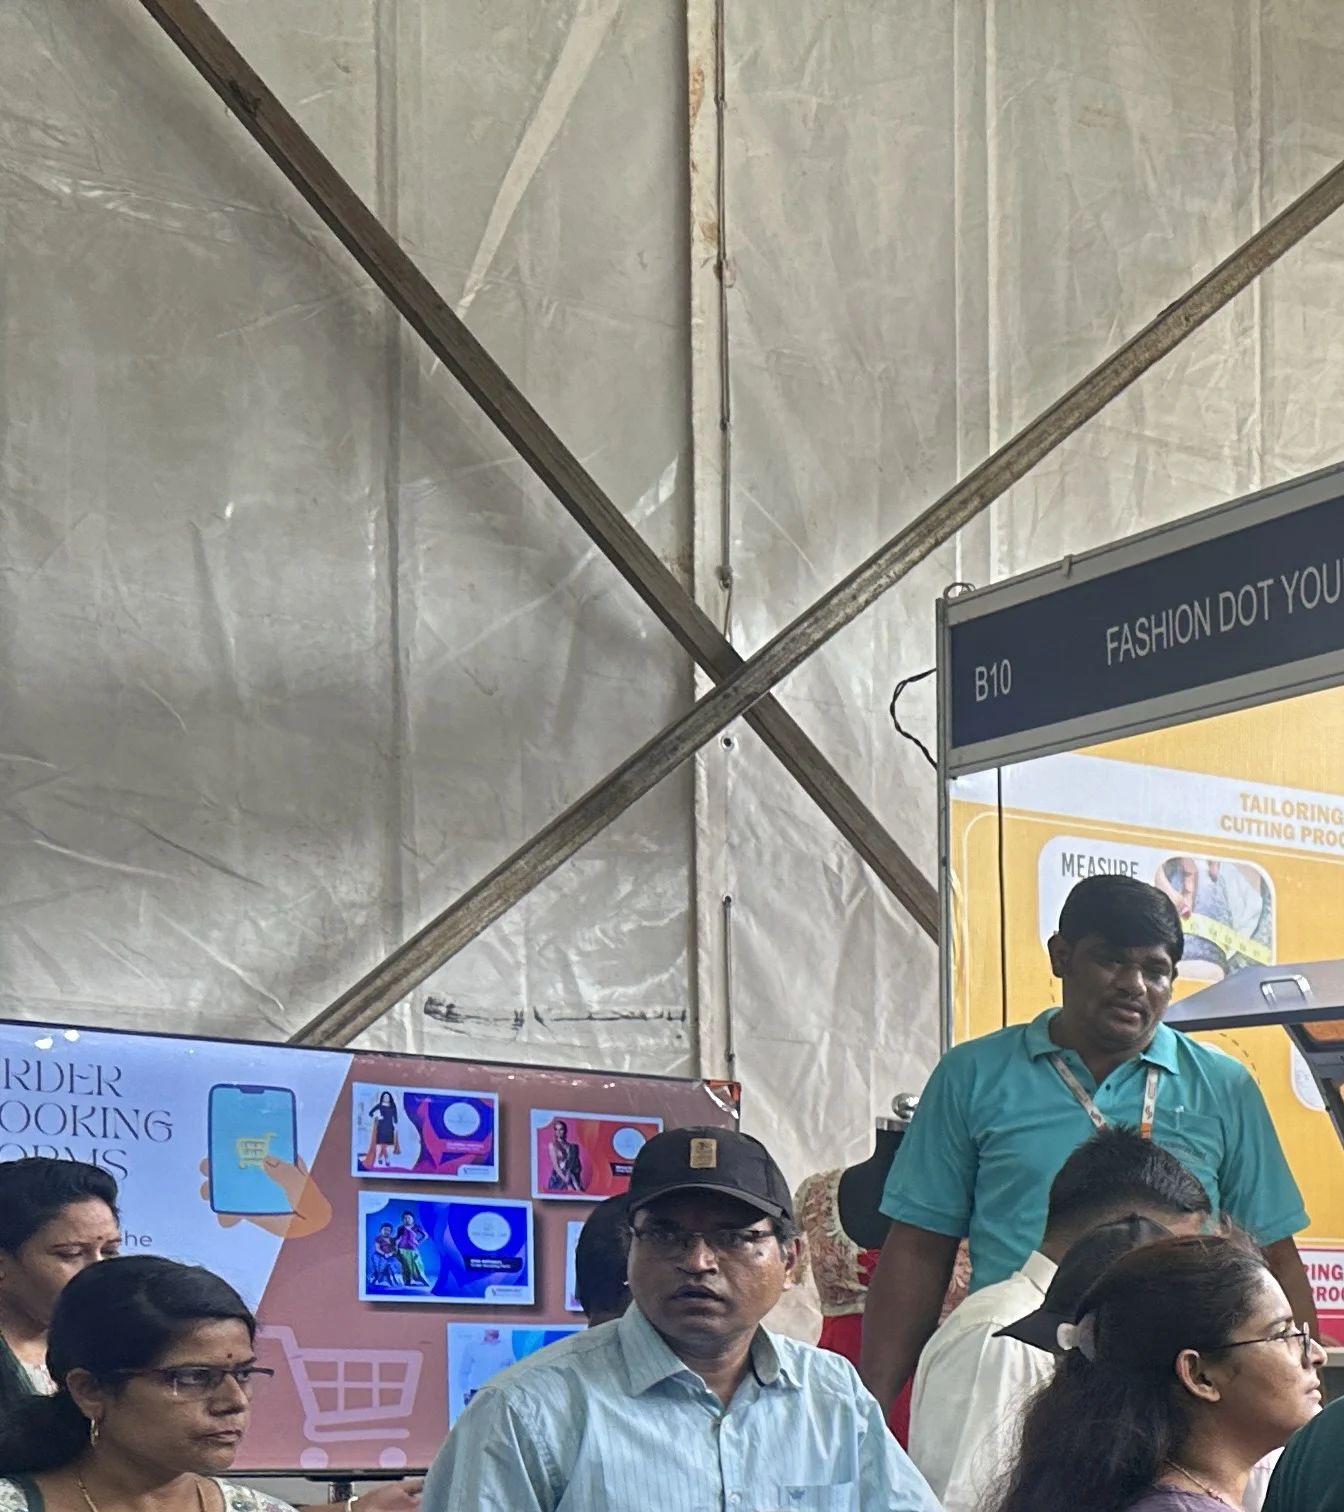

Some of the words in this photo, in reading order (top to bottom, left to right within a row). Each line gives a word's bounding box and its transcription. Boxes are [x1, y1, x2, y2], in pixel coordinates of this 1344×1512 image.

[1106, 597, 1211, 666] FASHION
[1219, 578, 1274, 632] DOT
[975, 659, 1012, 701] B10
[1220, 815, 1295, 841] CUTTING
[1240, 793, 1343, 826] TAILORING
